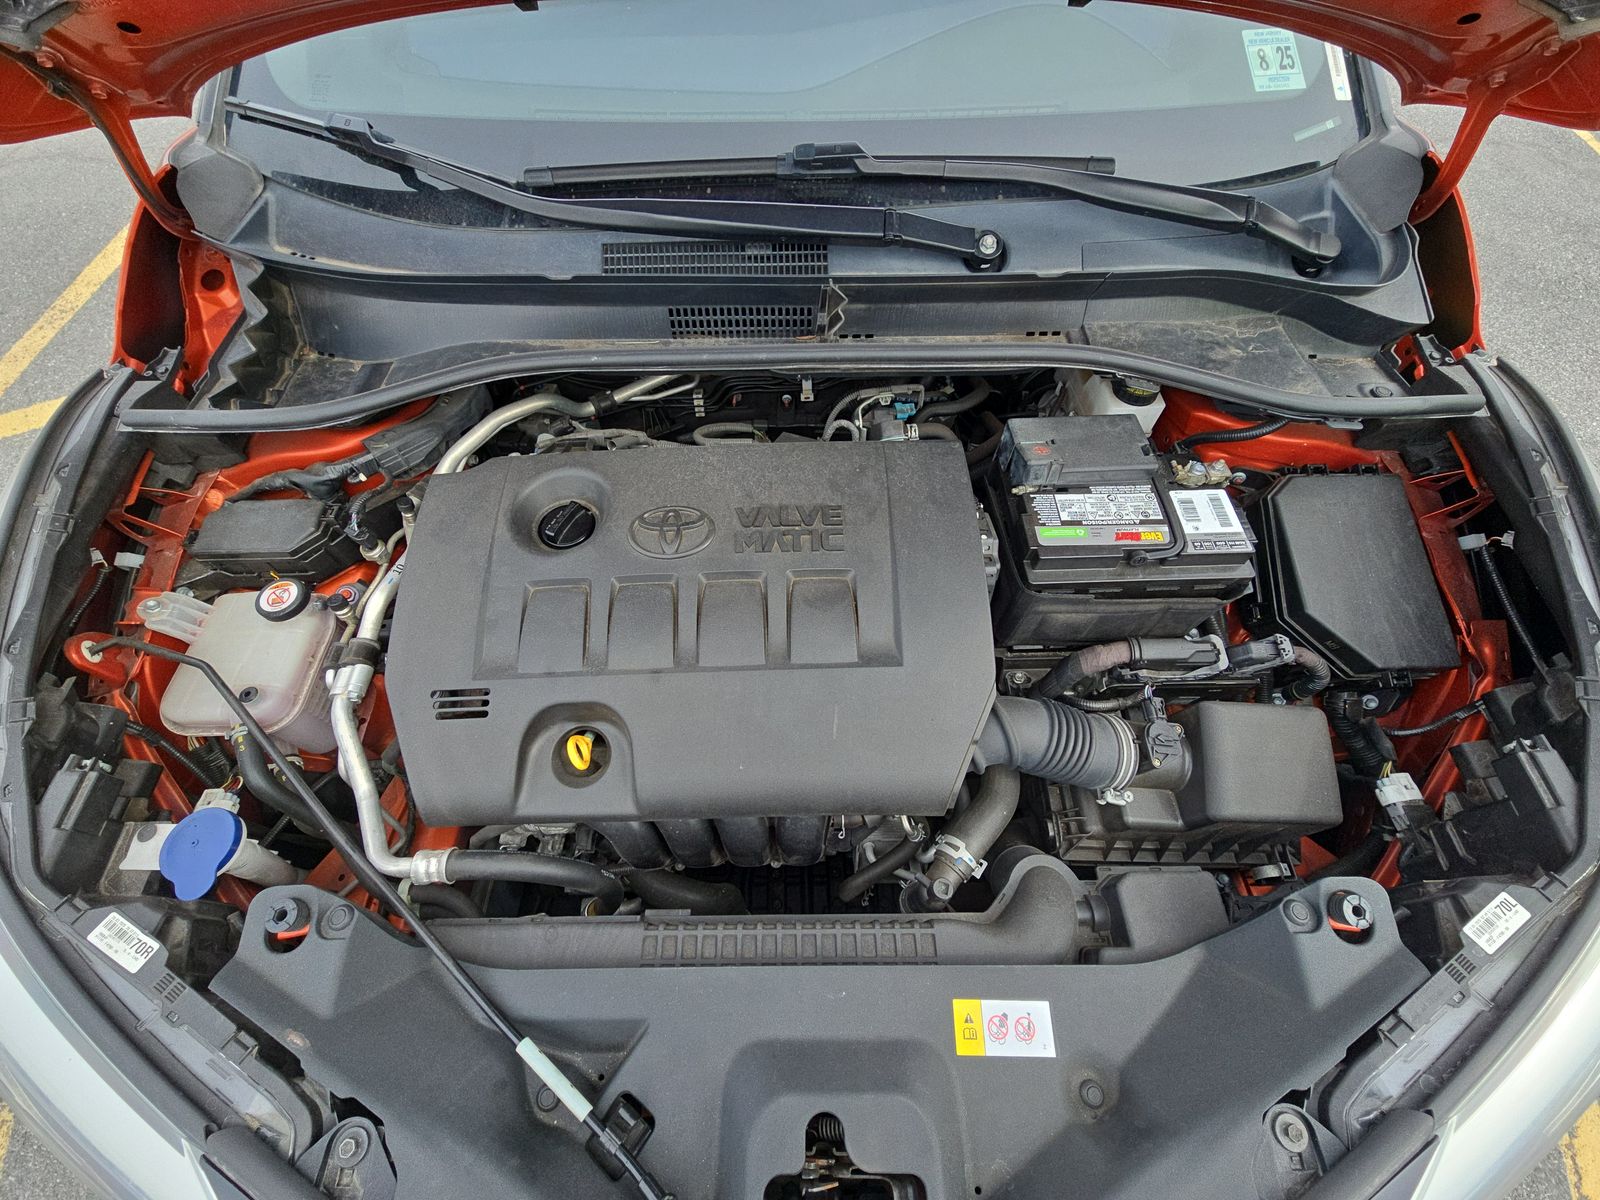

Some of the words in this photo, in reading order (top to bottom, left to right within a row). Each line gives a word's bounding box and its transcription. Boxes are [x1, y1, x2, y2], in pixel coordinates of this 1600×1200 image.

[1257, 48, 1270, 71] 8
[1275, 45, 1296, 70] 25
[734, 504, 844, 528] VALVE
[734, 528, 845, 553] MATIC
[1494, 897, 1518, 917] 70L
[129, 938, 155, 960] 70R
